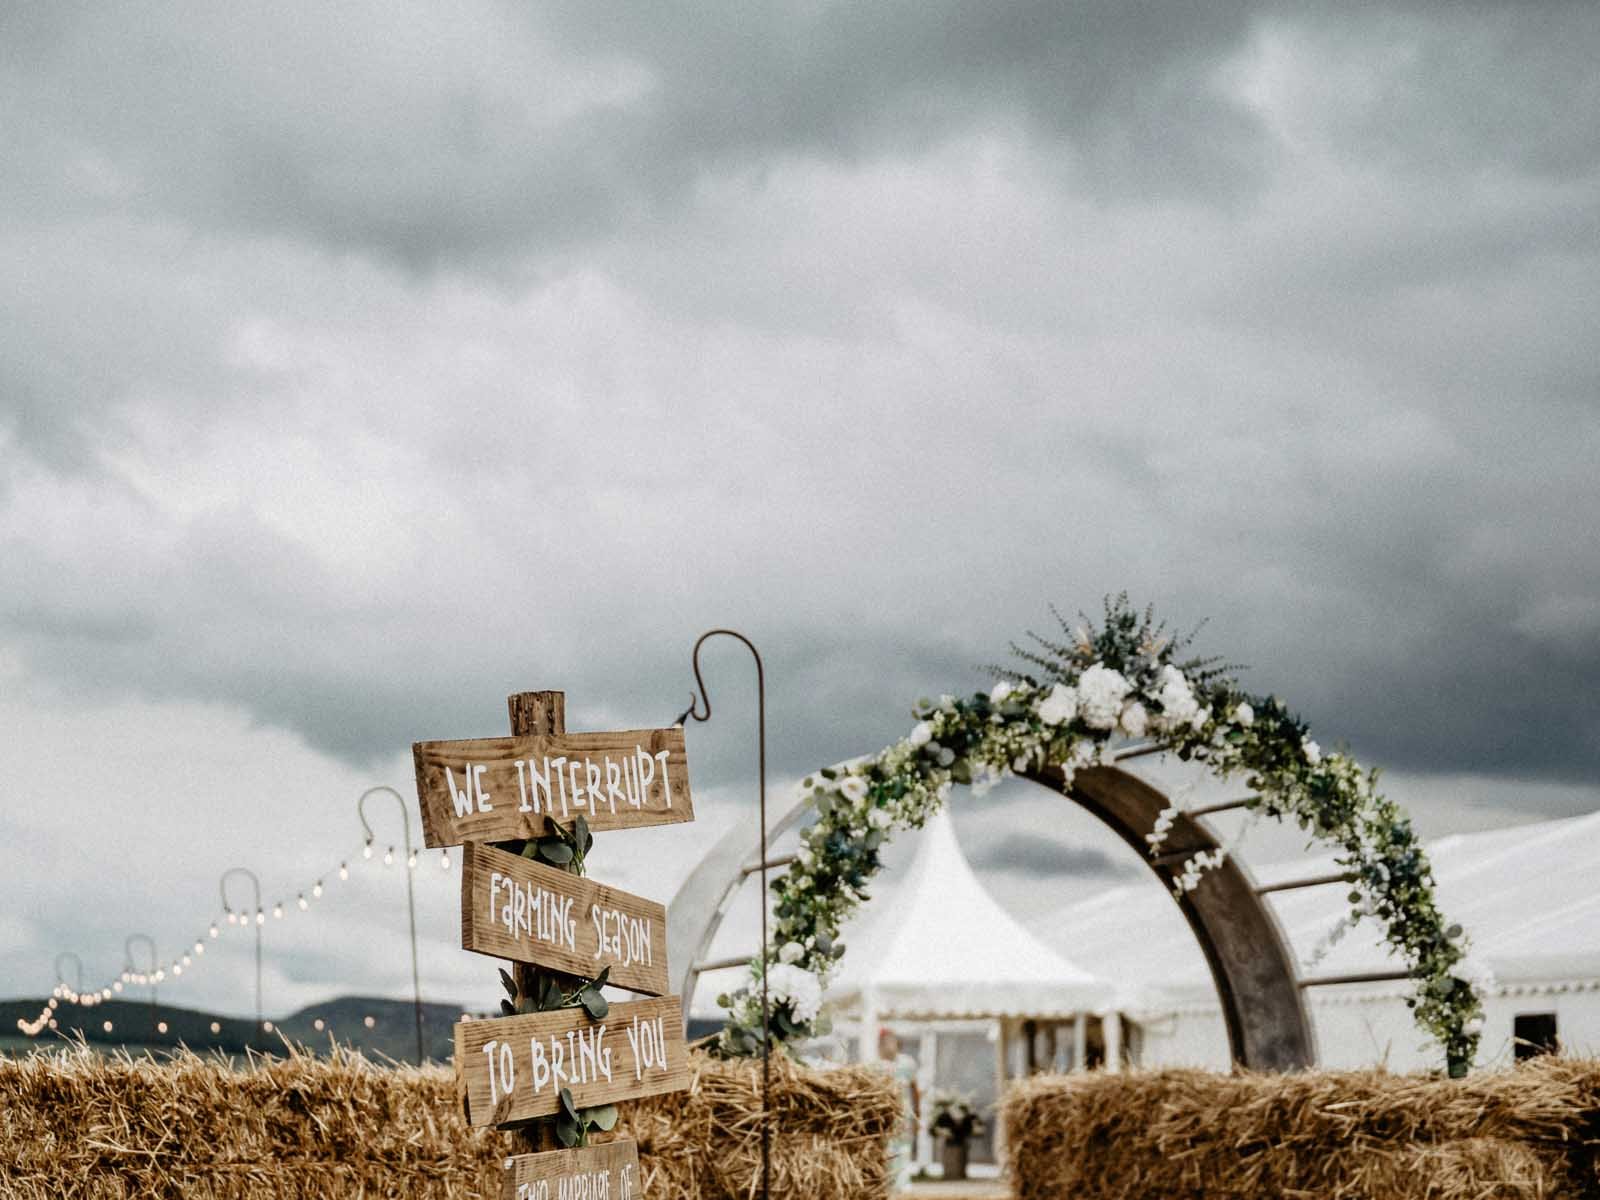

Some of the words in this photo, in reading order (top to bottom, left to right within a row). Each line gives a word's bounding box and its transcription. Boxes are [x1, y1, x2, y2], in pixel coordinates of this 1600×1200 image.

[445, 762, 493, 818] WE
[513, 744, 671, 817] INTERRUPT
[483, 1040, 514, 1105] TO
[531, 1025, 612, 1095] BRING
[626, 1015, 668, 1081] YOU
